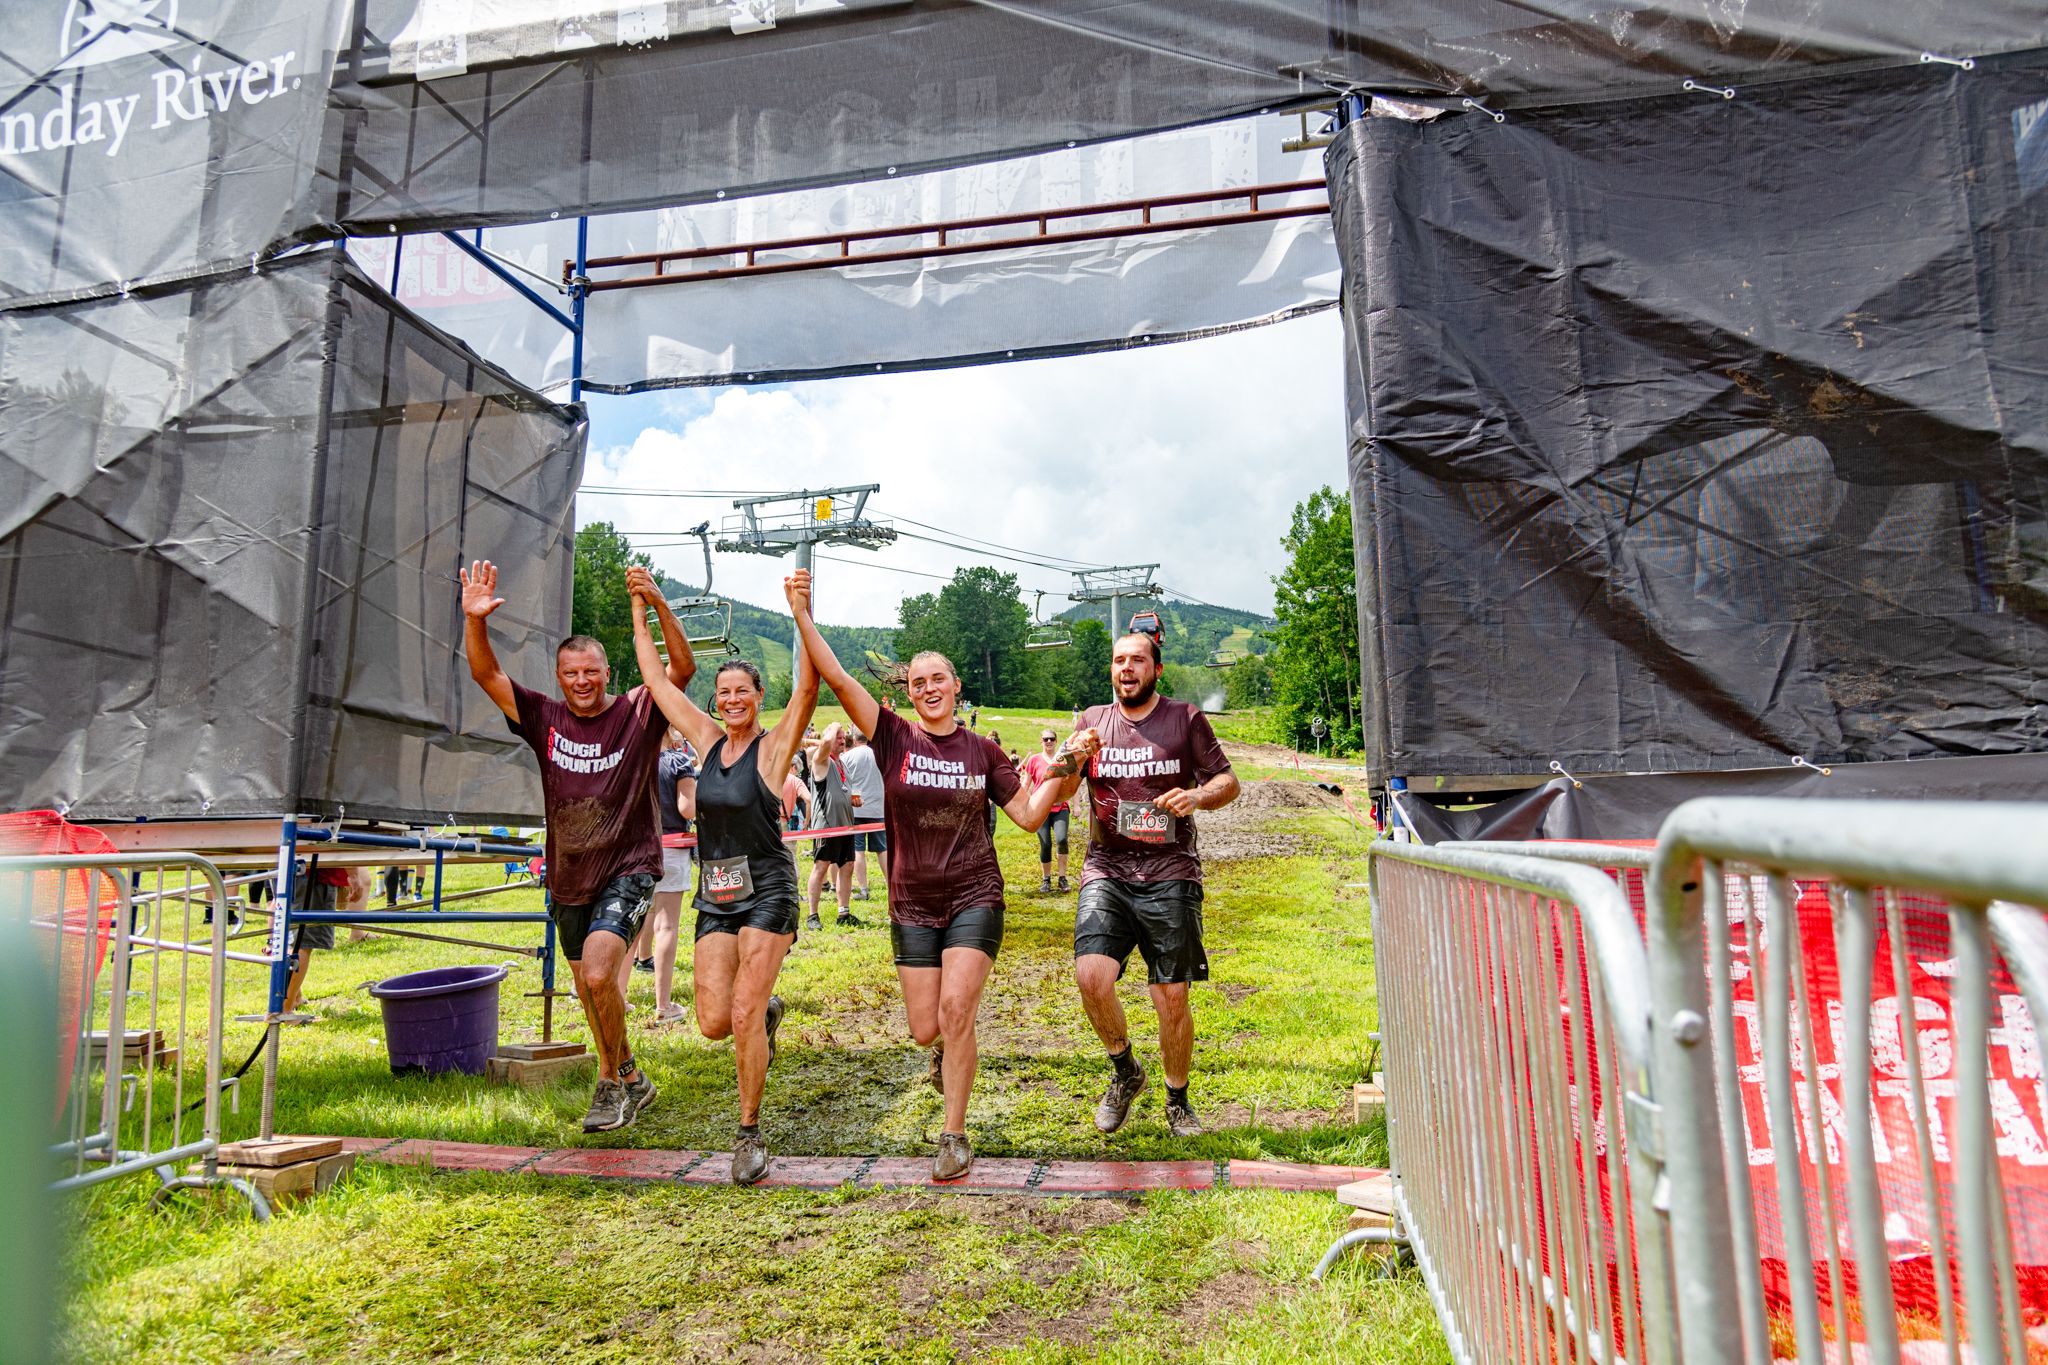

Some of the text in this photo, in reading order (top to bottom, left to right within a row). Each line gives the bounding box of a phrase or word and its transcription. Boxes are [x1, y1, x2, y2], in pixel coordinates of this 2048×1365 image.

[553, 731, 601, 758] TOUGH
[1100, 745, 1153, 763] TOUGH
[552, 746, 625, 774] MOUNTAIN
[909, 752, 965, 774] TOUGH
[1098, 759, 1181, 778] MOUNTAIN
[905, 769, 986, 790] MOUNTAIN
[1125, 813, 1169, 831] 1409
[705, 869, 744, 891] 1495
